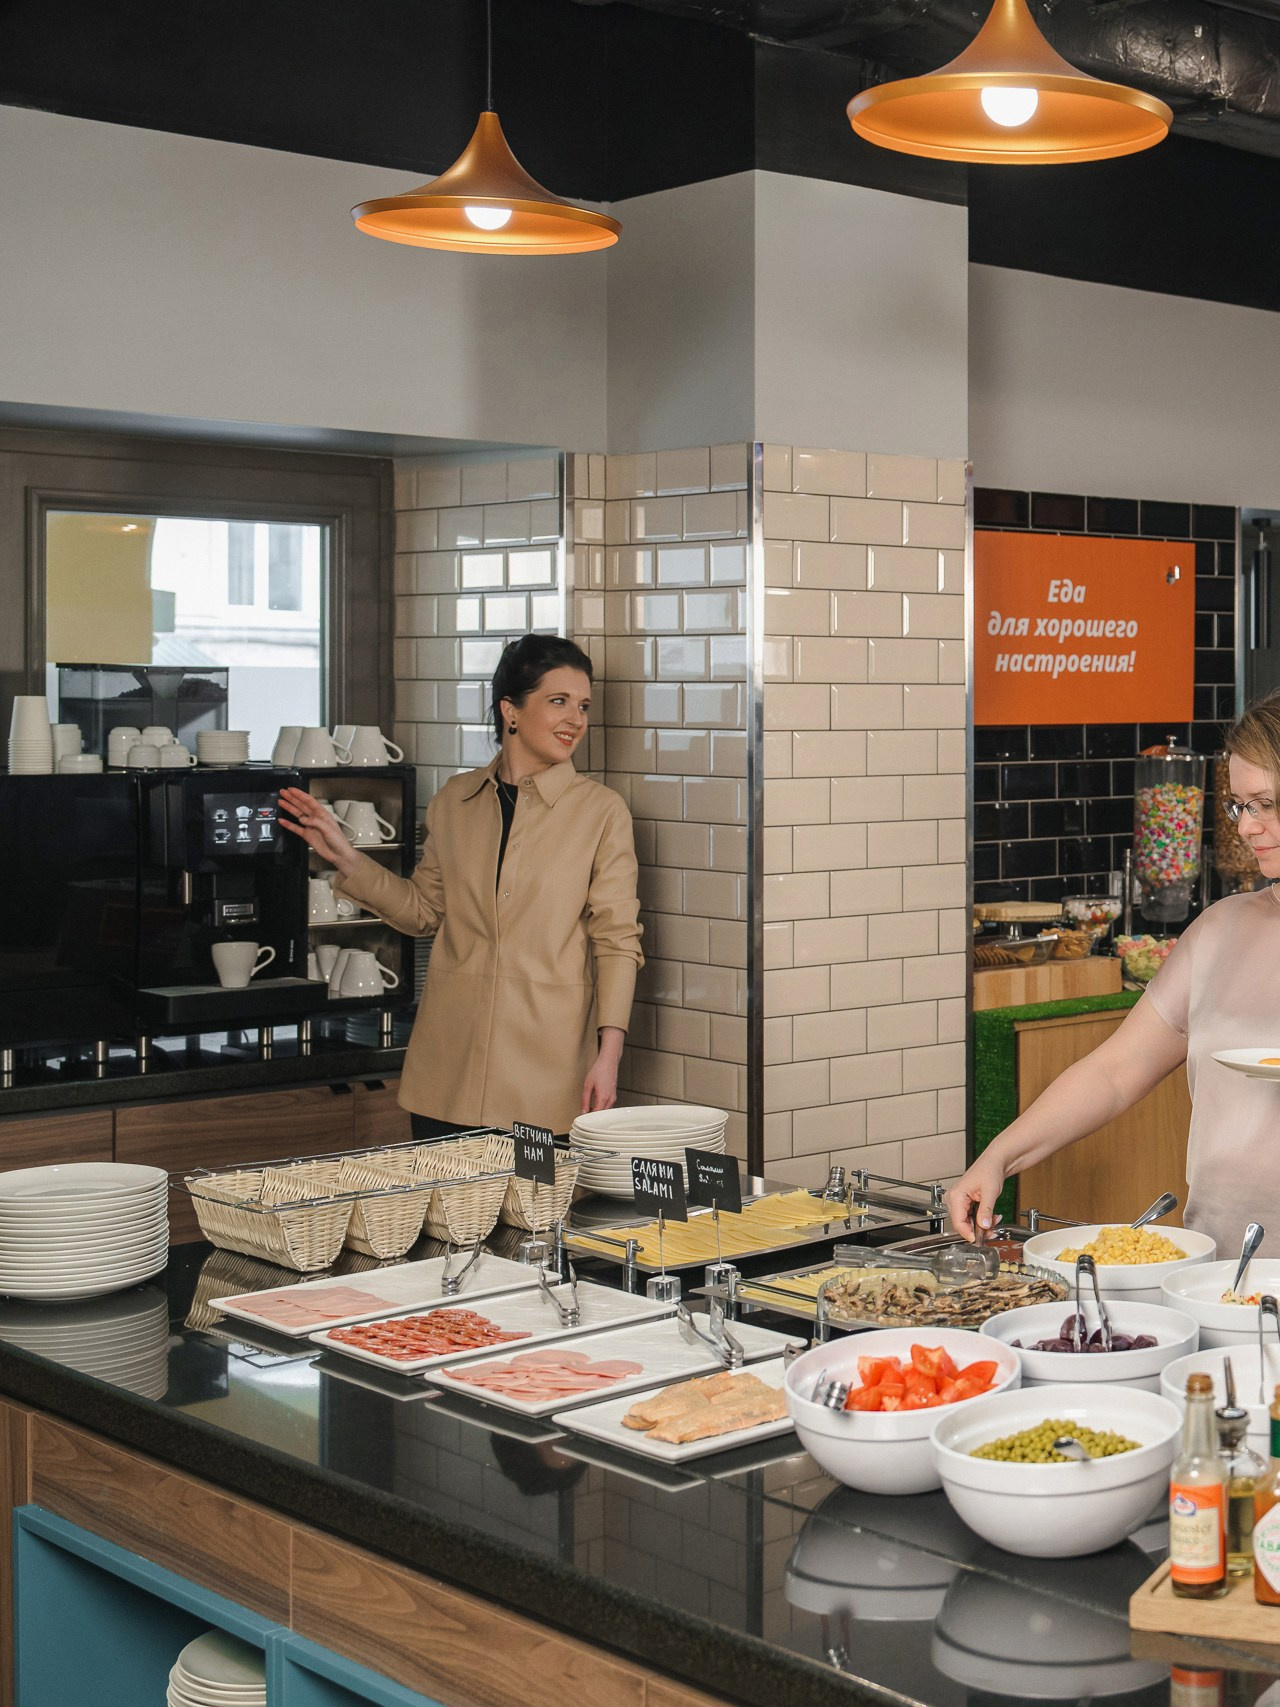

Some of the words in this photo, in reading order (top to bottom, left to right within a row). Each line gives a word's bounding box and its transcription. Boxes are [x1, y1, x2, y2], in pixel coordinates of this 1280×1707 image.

[1047, 578, 1087, 604] Еда
[986, 610, 1030, 637] для
[1033, 617, 1139, 644] хорошего
[994, 650, 1137, 680] настроения!
[514, 1123, 553, 1146] ВЕТЧИНА
[524, 1145, 544, 1162] HAM
[632, 1159, 674, 1181] САЛЯМИ
[634, 1174, 673, 1200] SALAMI
